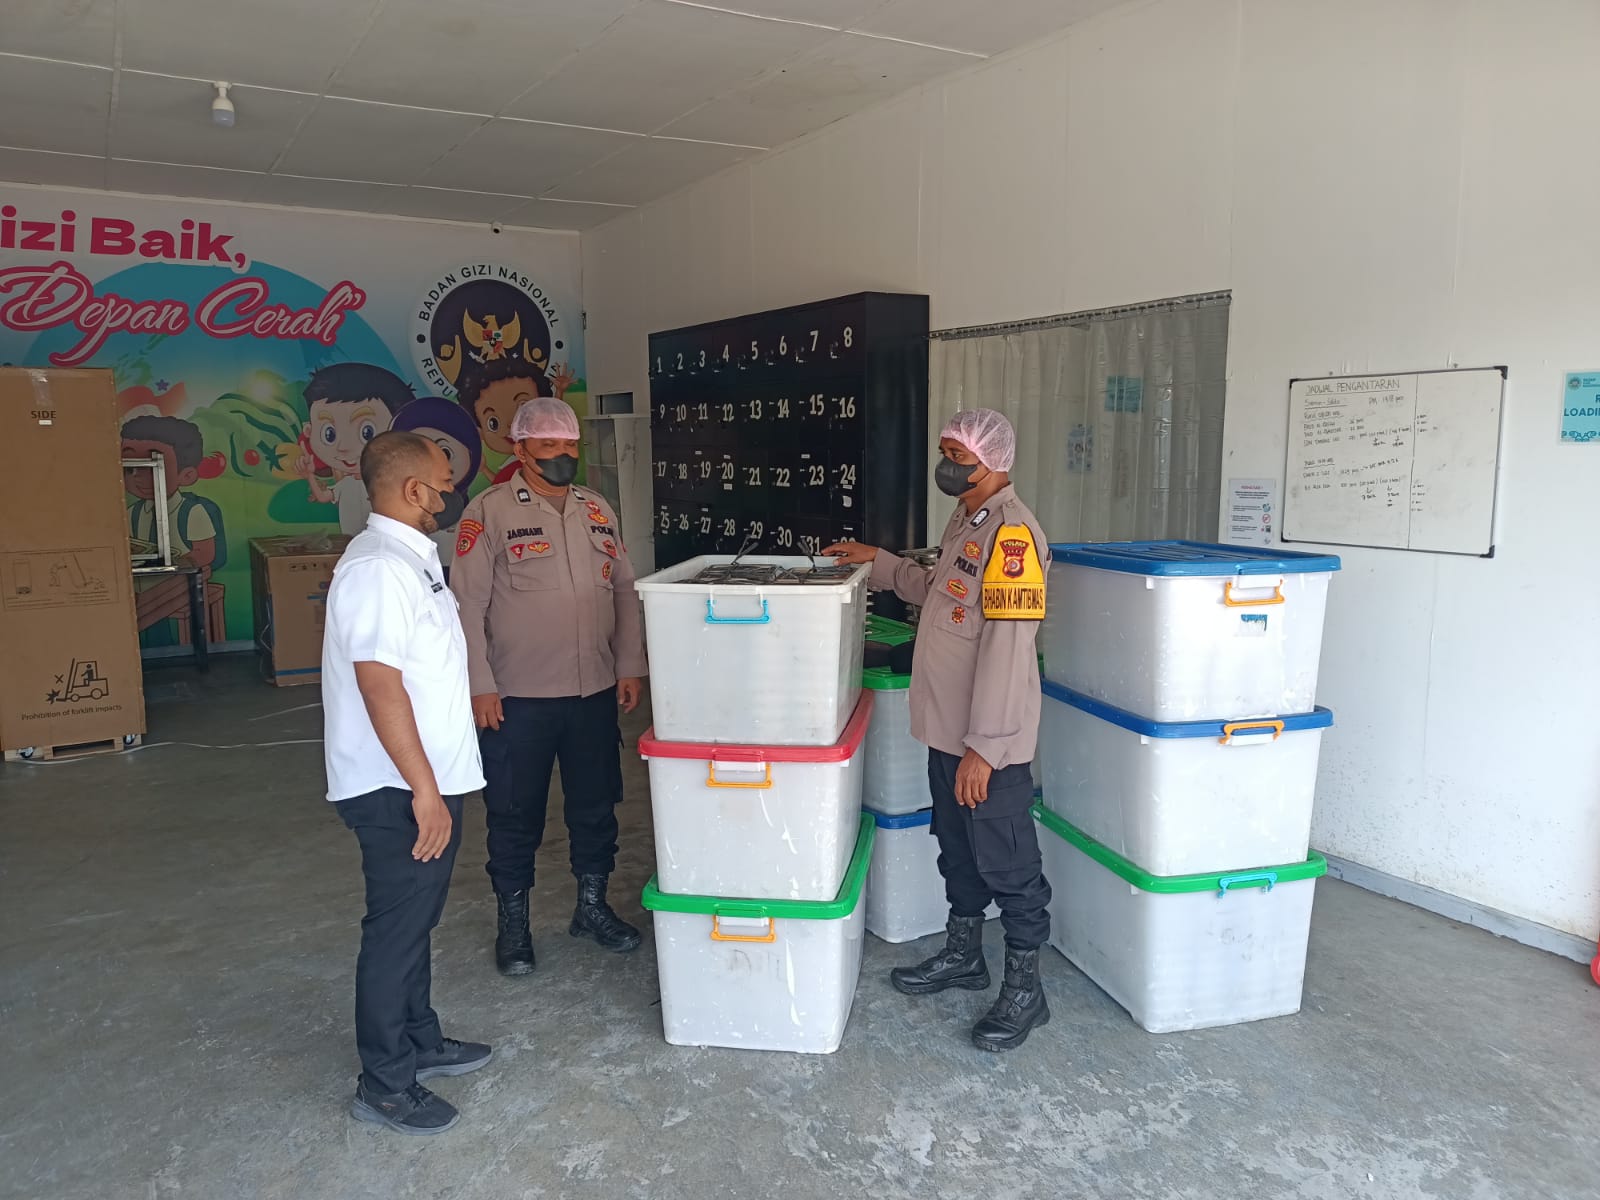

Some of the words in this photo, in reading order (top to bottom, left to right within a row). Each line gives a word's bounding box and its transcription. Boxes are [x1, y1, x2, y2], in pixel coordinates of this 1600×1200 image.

[1, 205, 76, 253] izi
[90, 217, 246, 268] Baik,
[419, 274, 457, 321] BADAN
[461, 264, 491, 278] GIZI
[498, 266, 559, 328] NASIONAL
[0, 261, 190, 366] Depan
[656, 356, 663, 373] 1
[677, 352, 684, 370] 2
[699, 350, 706, 368] 3
[722, 344, 730, 362] 4
[751, 340, 759, 360] 5
[779, 335, 788, 356] 6
[809, 330, 819, 352] 7
[843, 326, 853, 348] 8
[421, 357, 454, 398] REPU
[1306, 384, 1334, 393] JADWAL
[1336, 379, 1400, 392] PENGANTARAN
[31, 410, 57, 419] SIDE
[659, 403, 666, 419] 9
[676, 403, 687, 422] 10
[697, 402, 709, 420] 11
[722, 403, 735, 422] 12
[749, 399, 762, 420] 13
[777, 398, 790, 419] 14
[809, 394, 825, 416] 15
[839, 396, 856, 418] 16
[656, 461, 667, 477] 17
[678, 463, 688, 480] 18
[700, 461, 712, 479] 19
[721, 462, 734, 480] 20
[748, 466, 762, 486] 21
[776, 467, 791, 487] 22
[808, 465, 825, 486] 23
[839, 463, 857, 485] 24
[507, 527, 544, 540] JASMANI
[660, 510, 670, 529] 25
[679, 513, 690, 530] 26
[700, 516, 712, 534] 27
[723, 518, 736, 537] 28
[750, 520, 764, 540] 29
[776, 526, 793, 548] 30
[806, 535, 822, 556] 31
[953, 556, 978, 577] POLRI
[984, 588, 1006, 610] BHABIN
[1008, 588, 1043, 610] KAMTIBMAS
[21, 711, 61, 720] Prohibition
[72, 706, 94, 715] forklift
[95, 704, 122, 713] impacts
